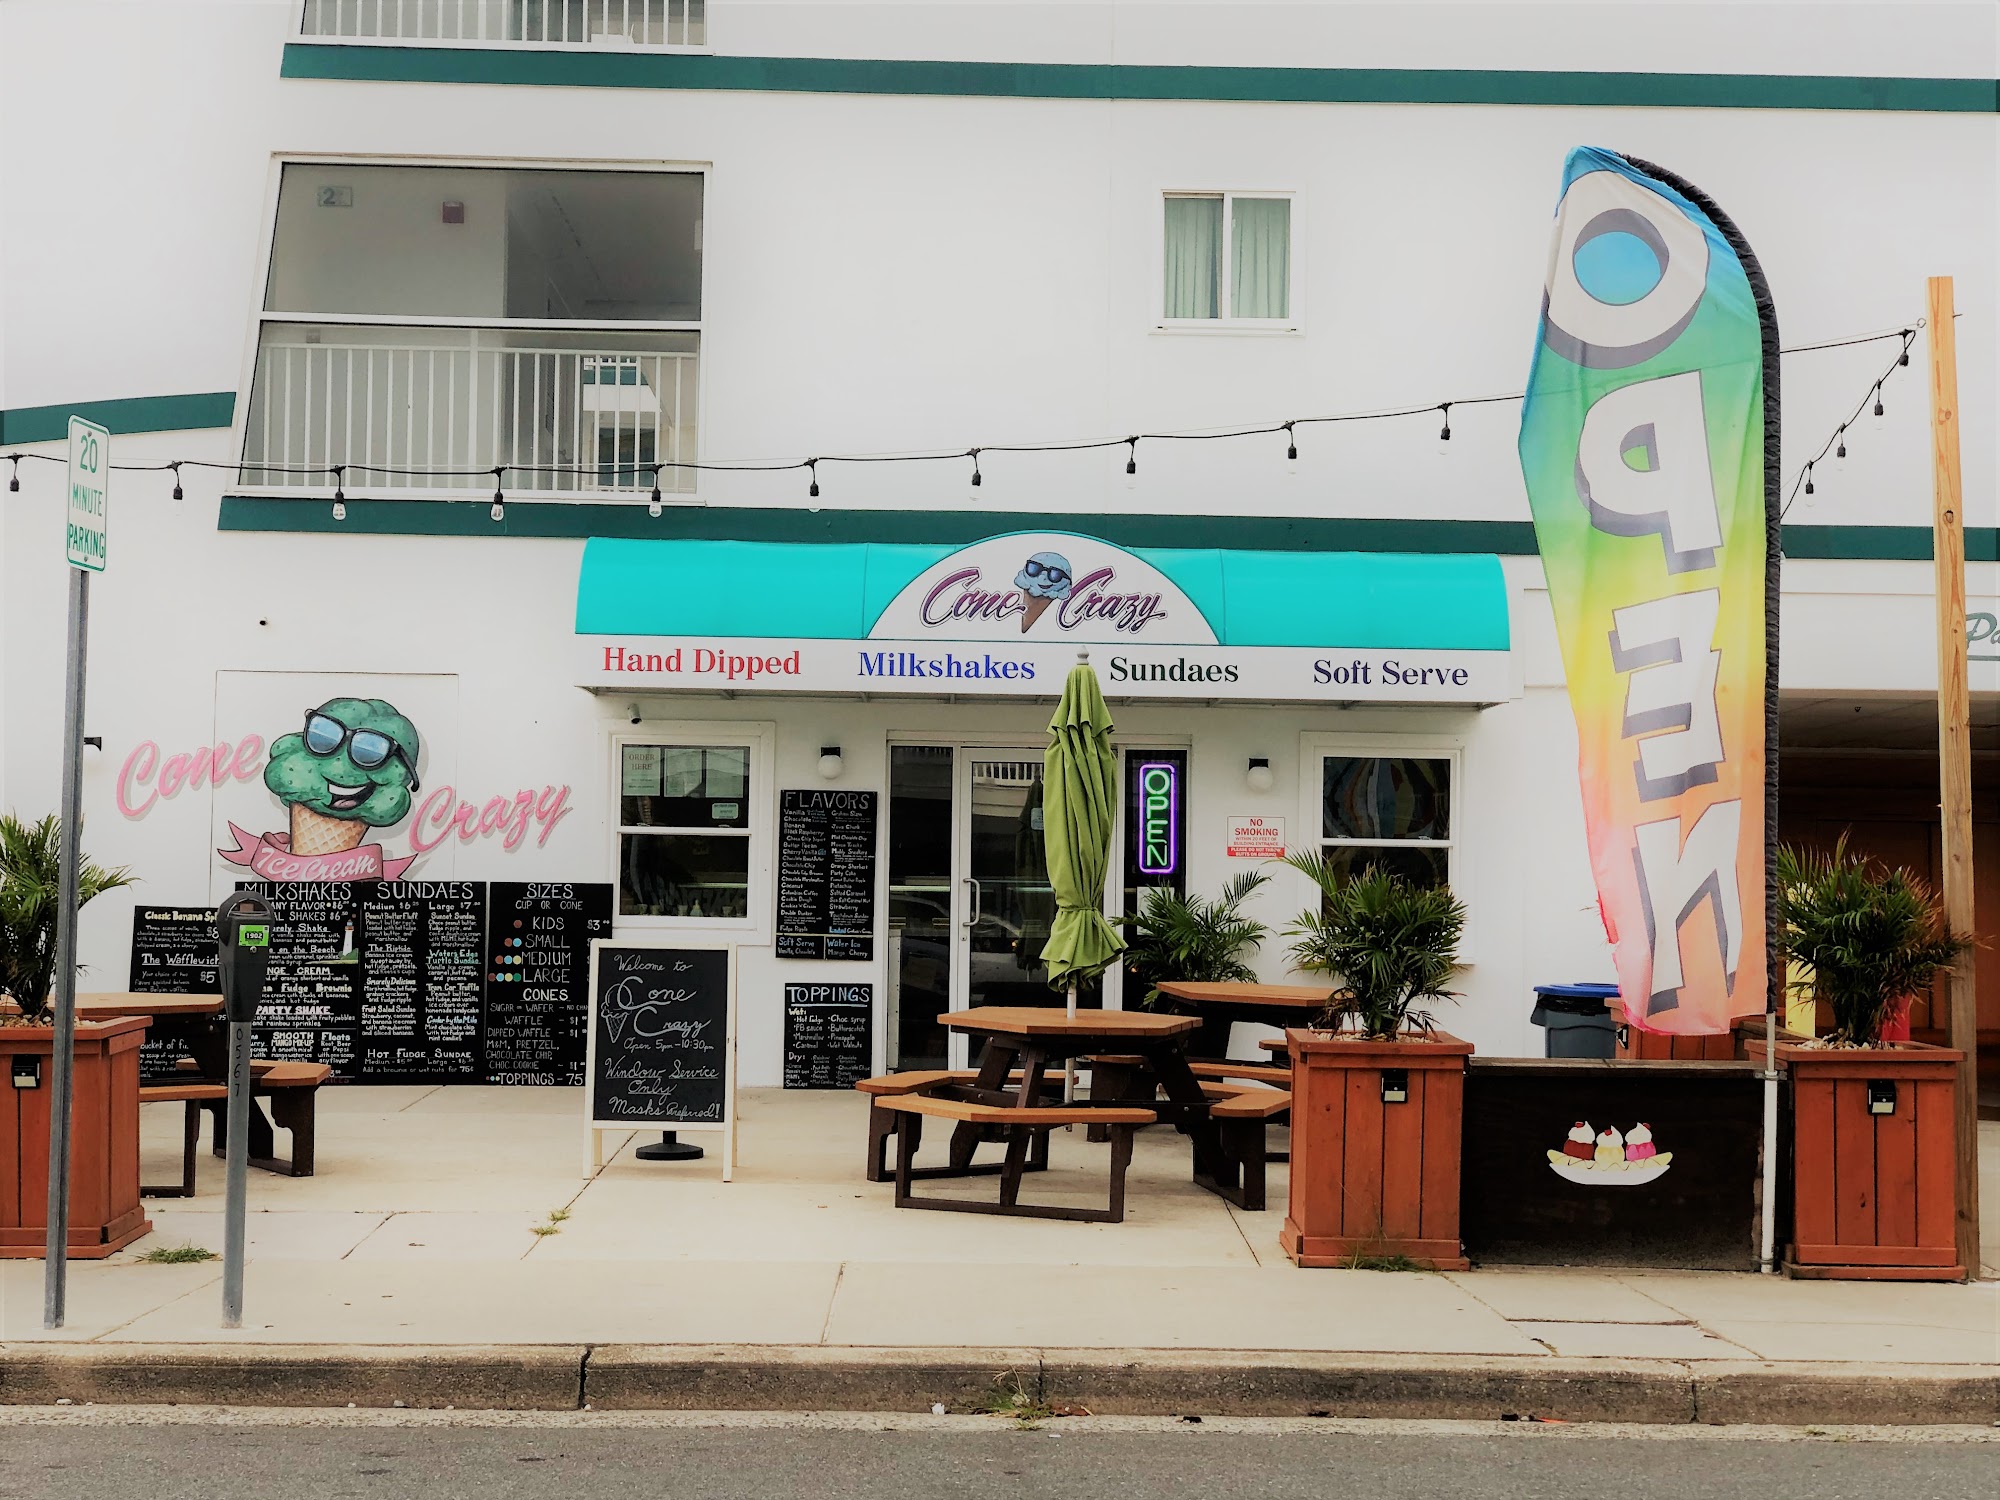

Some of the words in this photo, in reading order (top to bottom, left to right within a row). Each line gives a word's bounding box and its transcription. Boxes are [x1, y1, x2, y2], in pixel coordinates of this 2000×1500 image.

[80, 435, 98, 473] 20
[73, 483, 103, 517] MINUTE
[69, 523, 105, 559] PARKING
[920, 567, 1027, 628] Cone
[1057, 567, 1167, 633] Crazy
[602, 646, 682, 673] Hand
[692, 649, 801, 680] Dipped
[858, 651, 1035, 680] Milkshakes
[1110, 656, 1239, 682] Sundaes
[1313, 659, 1371, 685] Soft
[1382, 660, 1469, 686] Serve
[116, 733, 264, 818] Cone
[408, 785, 572, 853] Crazy
[785, 792, 869, 809] FLAVORS
[1144, 769, 1170, 866] OPEN
[1250, 818, 1263, 826] NO
[1234, 828, 1278, 836] SMOKING
[258, 847, 299, 879] Ice
[304, 855, 378, 881] Cream
[244, 882, 352, 900] MILKSHAKES
[377, 882, 474, 899] SUNDAES
[526, 882, 574, 899] SIZES
[290, 902, 325, 910] FLAVOR
[364, 902, 394, 910] Medium
[429, 902, 455, 912] Large
[515, 900, 532, 910] CUP
[540, 901, 551, 910] OR
[560, 901, 583, 910] CONE
[829, 903, 859, 911] Strawberry
[144, 911, 171, 920] Classic
[172, 910, 203, 921] Banana
[204, 911, 218, 923] Spl
[289, 911, 328, 921] SHAKES
[454, 912, 475, 920] Sundae
[297, 923, 328, 932] Shake
[532, 916, 565, 931] KIDS
[525, 933, 570, 948] SMALL
[779, 937, 794, 946] Soft
[796, 938, 815, 947] Serve
[827, 938, 848, 947] Water
[851, 939, 861, 948] Ice
[311, 945, 335, 953] Beach
[368, 944, 383, 952] The
[460, 949, 478, 958] Edge
[849, 949, 868, 958] Cherry
[141, 953, 160, 964] The
[426, 956, 452, 964] Turtle
[521, 951, 571, 965] MEDIUM
[614, 953, 665, 972] Welcome
[673, 960, 693, 972] to
[200, 971, 216, 983] $5
[523, 968, 570, 983] LARGE
[281, 983, 308, 994] Fudge
[315, 983, 352, 992] Brownie
[426, 983, 442, 991] Tram
[444, 983, 456, 991] Car
[523, 988, 569, 1001] CONES
[617, 976, 697, 1010] Cone
[786, 986, 870, 1002] TOPPINGS
[255, 1005, 292, 1014] PARTY
[294, 1005, 331, 1014] SHAKE
[378, 1005, 395, 1013] Salad
[490, 1003, 515, 1012] SUGAR
[525, 1004, 554, 1012] WAFER
[504, 1016, 543, 1025] WAFFLE
[634, 1006, 712, 1038] Crazy
[830, 1014, 848, 1022] Choc
[273, 1032, 314, 1040] SMOOTH
[321, 1032, 351, 1040] Floats
[488, 1028, 515, 1037] DIPPED
[517, 1028, 551, 1037] WAFFLE
[623, 1037, 651, 1050] Open
[486, 1050, 532, 1059] CHOCOLATE
[513, 1061, 539, 1069] COOKIE
[605, 1055, 666, 1078] Window
[669, 1059, 719, 1078] Service
[498, 1073, 555, 1085] TOPPINGS
[628, 1078, 677, 1105] Only
[608, 1096, 665, 1114] Masks
